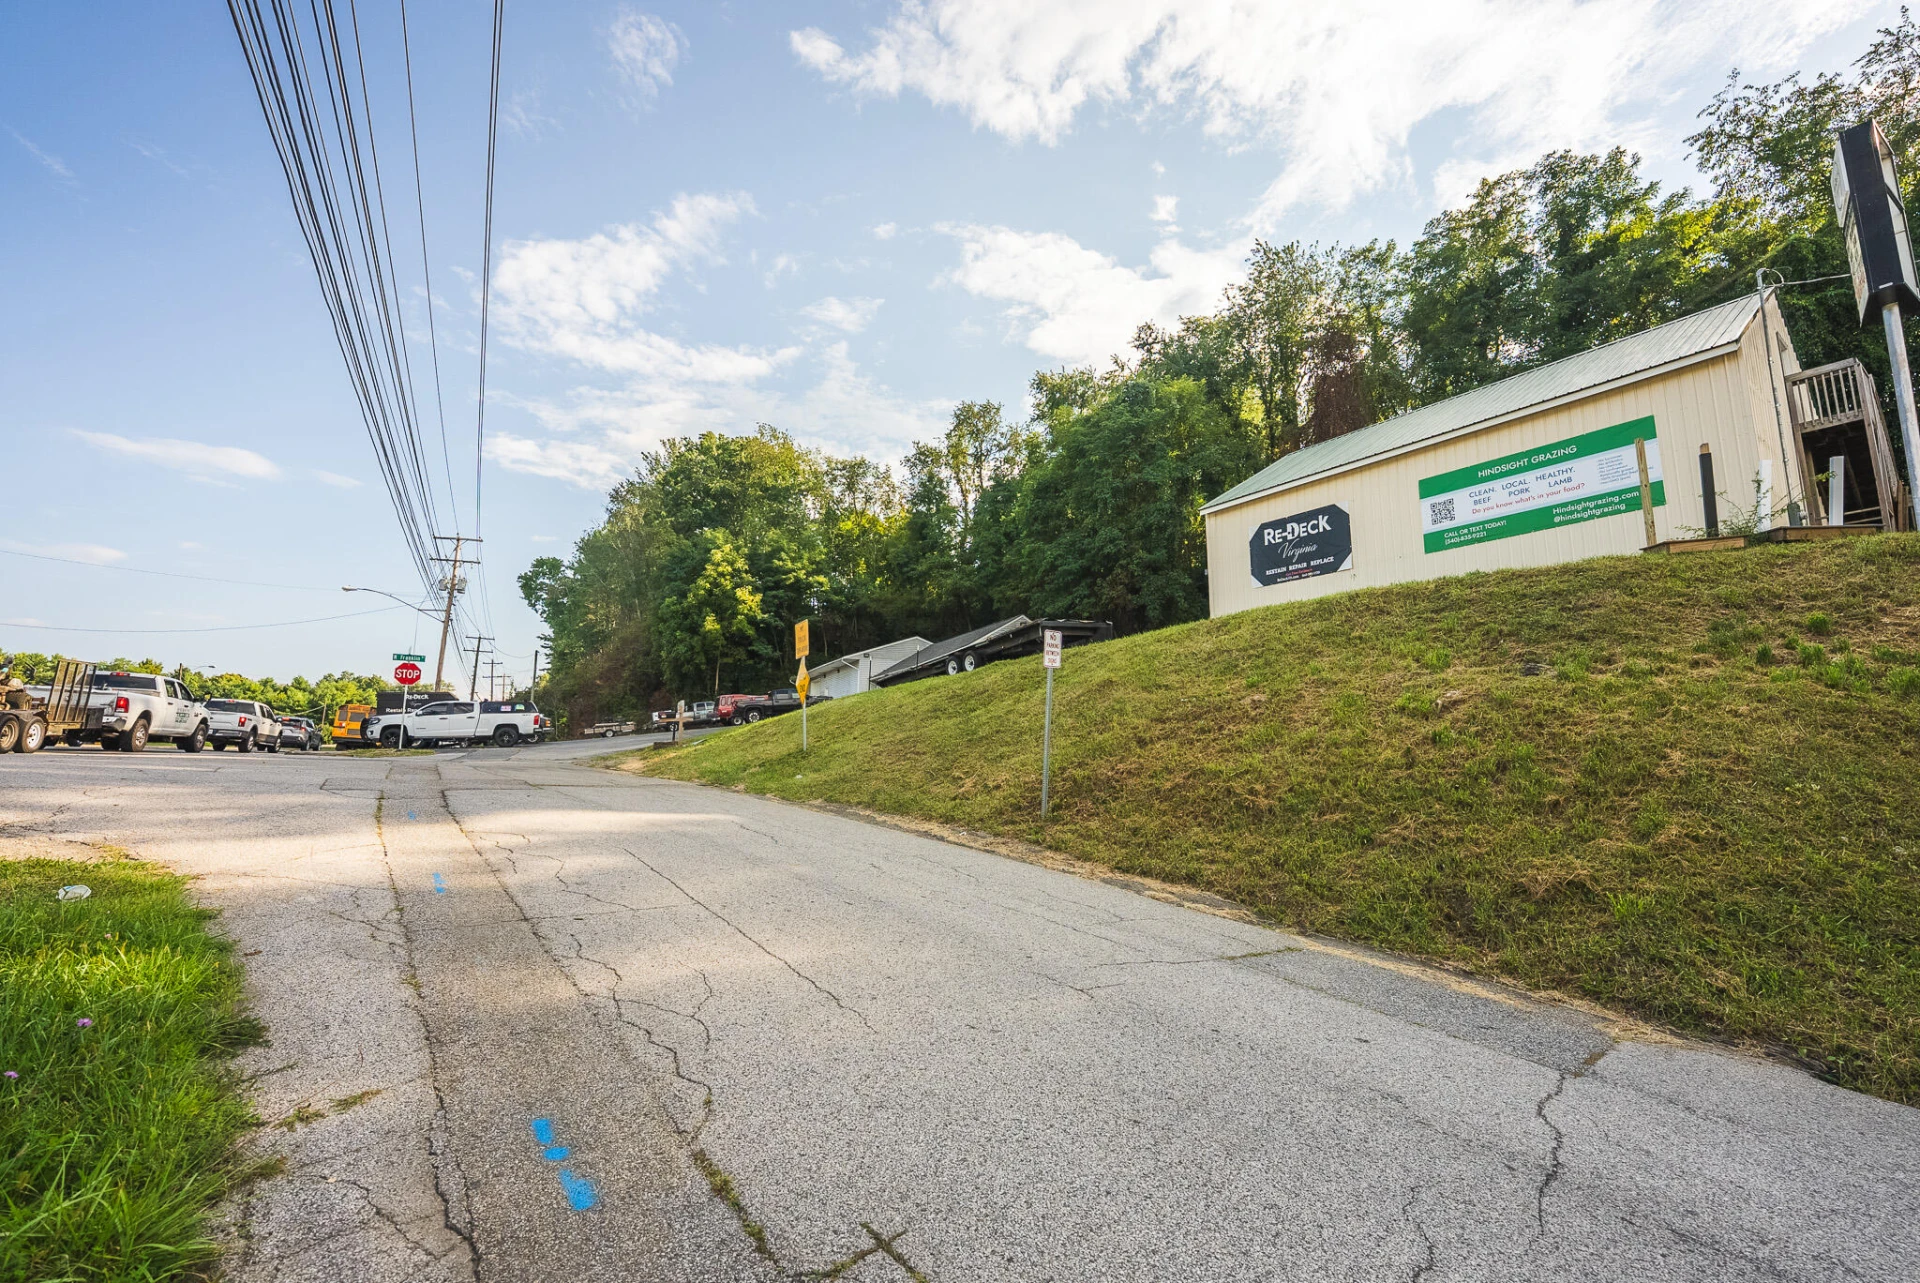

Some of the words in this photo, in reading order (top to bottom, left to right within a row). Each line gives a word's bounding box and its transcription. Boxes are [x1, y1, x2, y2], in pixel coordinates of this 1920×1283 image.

[1478, 458, 1528, 478] HINDSIGHT
[1531, 445, 1577, 463] GRAZING
[1468, 486, 1497, 498] CLEAN.
[1501, 479, 1531, 490] LOCAL.
[1535, 466, 1576, 481] HEALTHY.
[1473, 496, 1491, 506] BEEF
[1508, 486, 1530, 497] PORK
[1548, 476, 1573, 488] LAMB
[1482, 505, 1494, 513] you
[1496, 501, 1513, 509] know
[1515, 495, 1536, 504] what's
[1546, 490, 1561, 498] your
[1563, 482, 1585, 492] food?
[1552, 491, 1639, 515] Hindsightgrazing.com
[1553, 503, 1626, 523] @hindsightgrazing
[1469, 525, 1483, 533] TEXT
[1484, 520, 1507, 530] TODAY!
[1278, 538, 1318, 563] Virginia
[1265, 566, 1287, 576] RESTAIN
[1288, 562, 1307, 571] REPAIR
[1310, 556, 1335, 567] REPLACE
[395, 669, 420, 679] STOP
